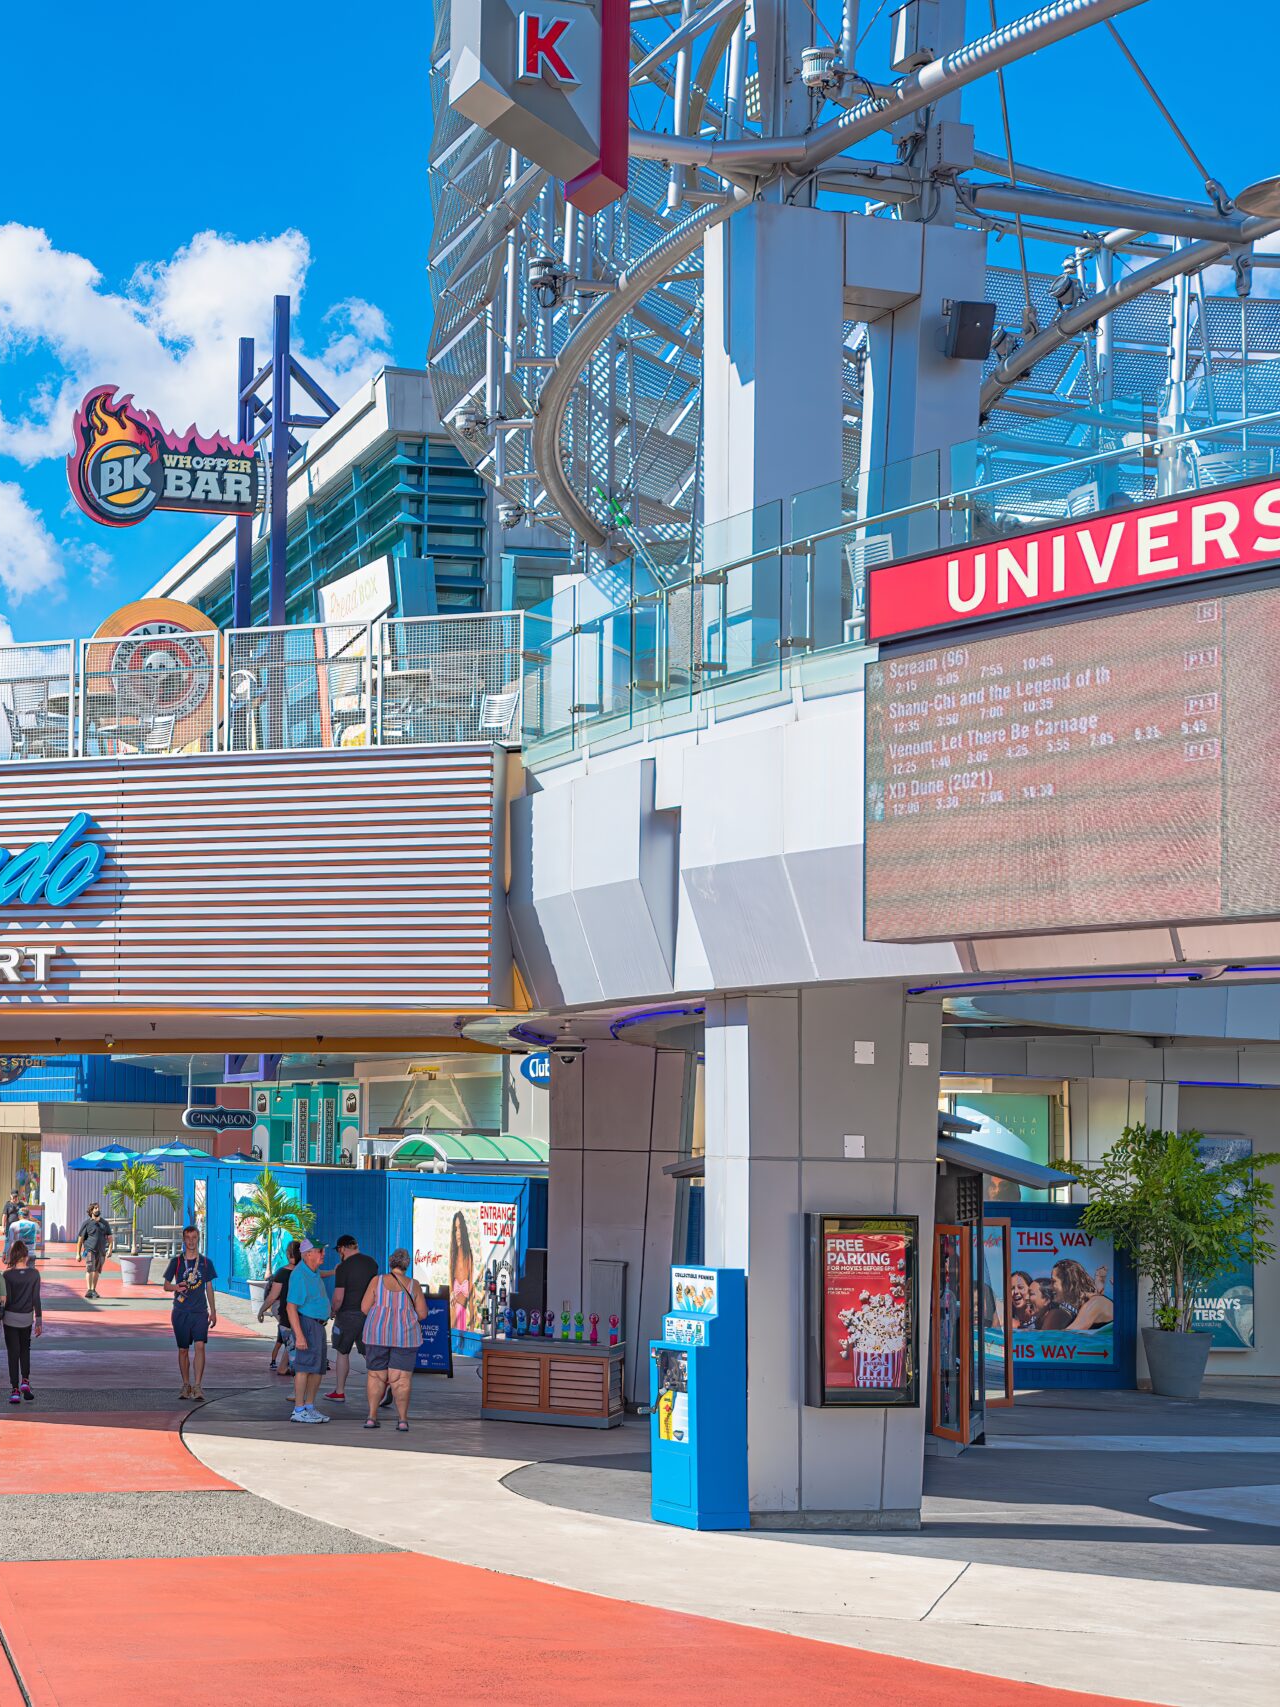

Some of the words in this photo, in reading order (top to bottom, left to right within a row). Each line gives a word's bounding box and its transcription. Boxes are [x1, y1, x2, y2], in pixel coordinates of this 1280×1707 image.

[519, 10, 582, 90] K
[162, 454, 252, 474] WHOPPER
[98, 452, 153, 499] BK
[162, 470, 252, 505] BAR
[946, 488, 1280, 614] UNIVERS
[889, 656, 938, 680] Scream
[941, 648, 970, 673] (96)
[895, 681, 918, 694] 2:15
[981, 666, 1004, 679] 7:55
[1022, 655, 1054, 671] 10:45
[889, 693, 956, 720] Shang-Chi
[960, 686, 985, 706] and
[989, 683, 1011, 702] the
[1016, 671, 1071, 698] Legend
[1075, 668, 1091, 688] of
[893, 721, 921, 734] 12:35
[1022, 698, 1054, 713] 10:35
[941, 733, 963, 752] Let
[967, 727, 1007, 748] There
[1010, 722, 1030, 741] Be
[1034, 714, 1099, 737] Carnage
[893, 762, 917, 775] 12:25
[889, 781, 906, 800] XD
[910, 777, 945, 797] Dune
[948, 770, 993, 795] (2021)
[10, 1057, 47, 1067] STORE
[191, 1112, 253, 1125] CINNABON
[480, 1205, 516, 1221] ENTRANCE
[483, 1222, 498, 1237] THIS
[500, 1222, 515, 1238] WAY
[1016, 1231, 1054, 1247] THIS
[1059, 1231, 1095, 1248] WAY
[826, 1239, 864, 1252] FREE
[826, 1252, 890, 1266] PARKING
[1188, 1297, 1240, 1310] ALWAYS
[1041, 1344, 1077, 1360] WAY
